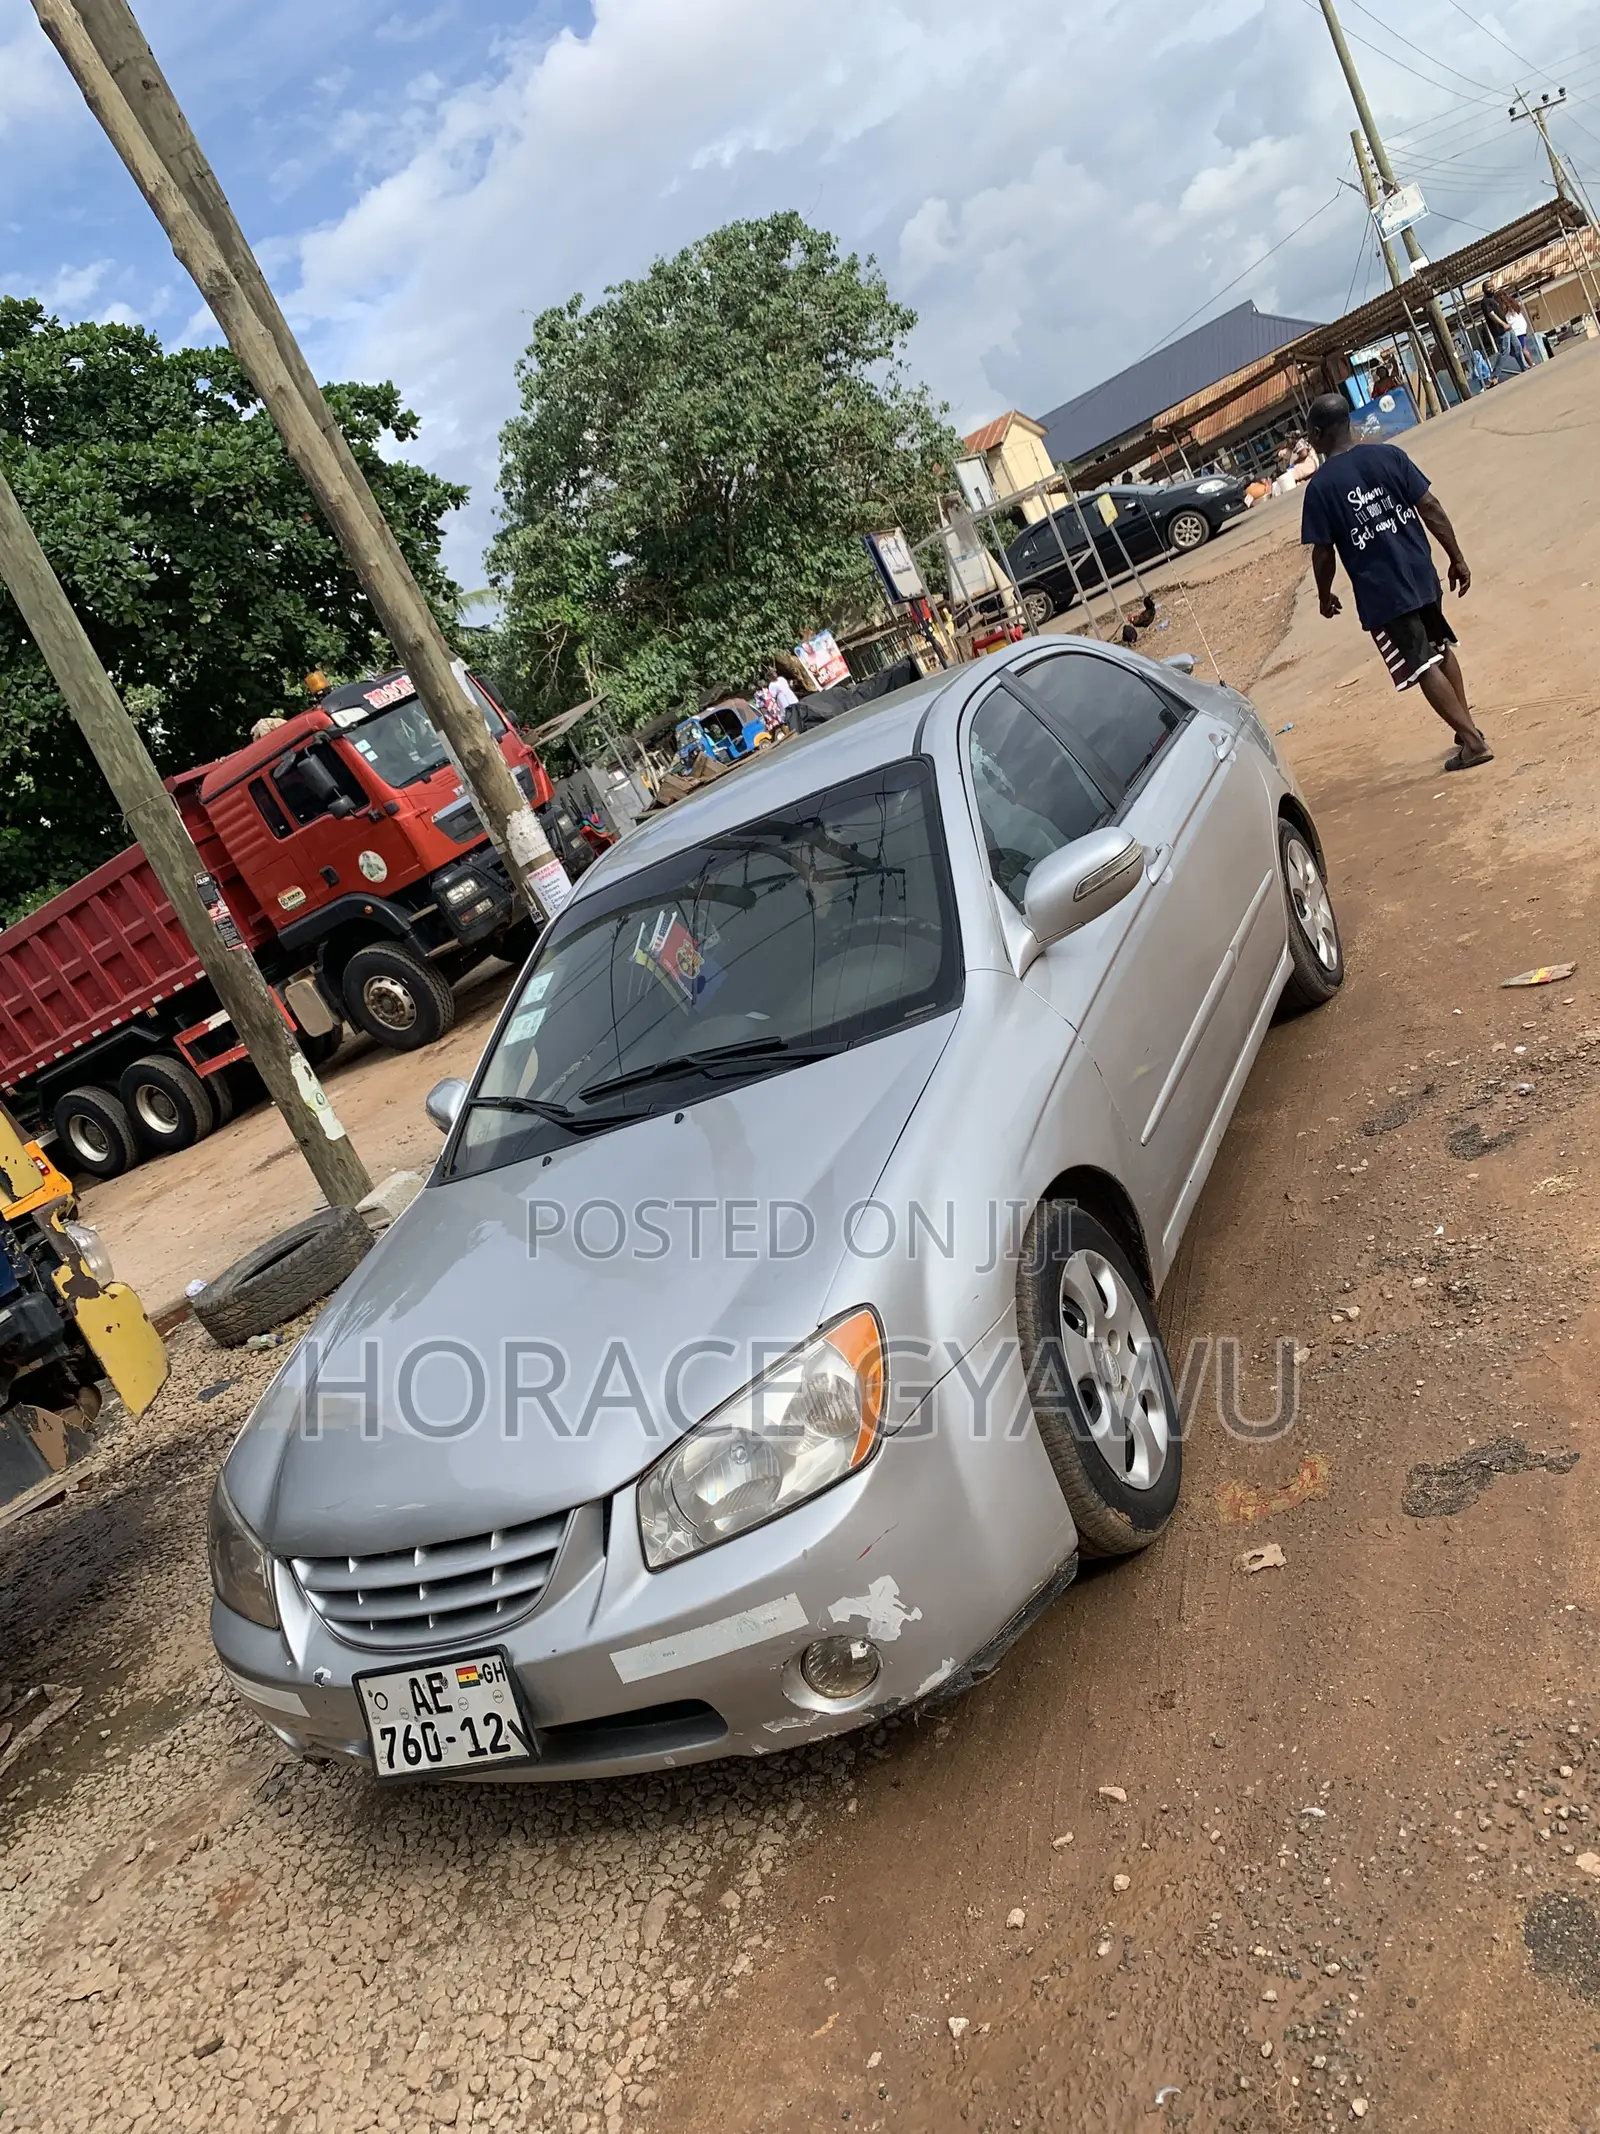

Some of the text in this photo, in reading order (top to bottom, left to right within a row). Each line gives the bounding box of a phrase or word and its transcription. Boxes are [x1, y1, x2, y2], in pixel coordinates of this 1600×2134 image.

[409, 1661, 507, 1716] AE GH
[380, 1712, 511, 1769] 760-12
